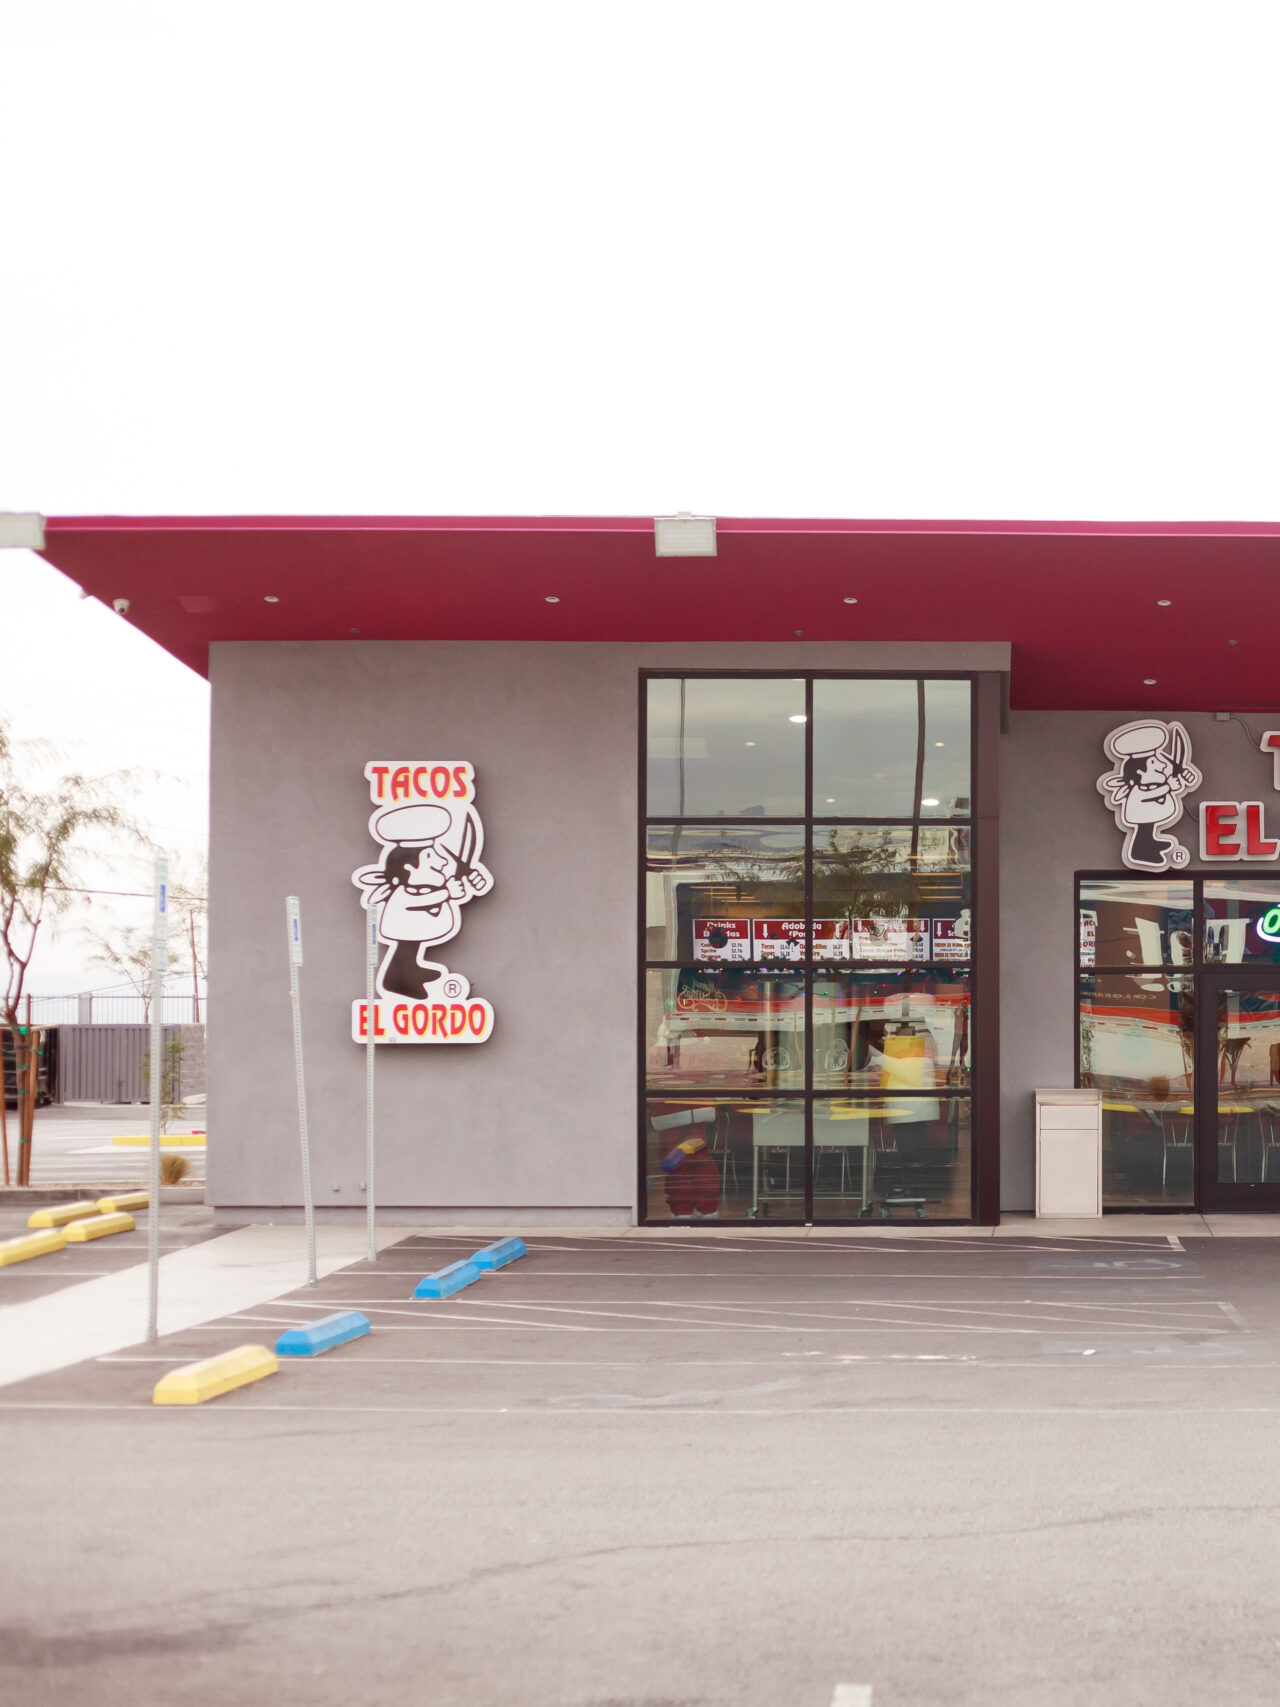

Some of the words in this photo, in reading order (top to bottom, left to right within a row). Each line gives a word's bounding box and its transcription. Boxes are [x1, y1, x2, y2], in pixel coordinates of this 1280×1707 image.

[371, 766, 469, 803] TACOS
[1205, 804, 1278, 856] EL
[782, 922, 822, 930] Adobda
[359, 1004, 387, 1037] EL
[392, 1003, 488, 1040] GORDO
